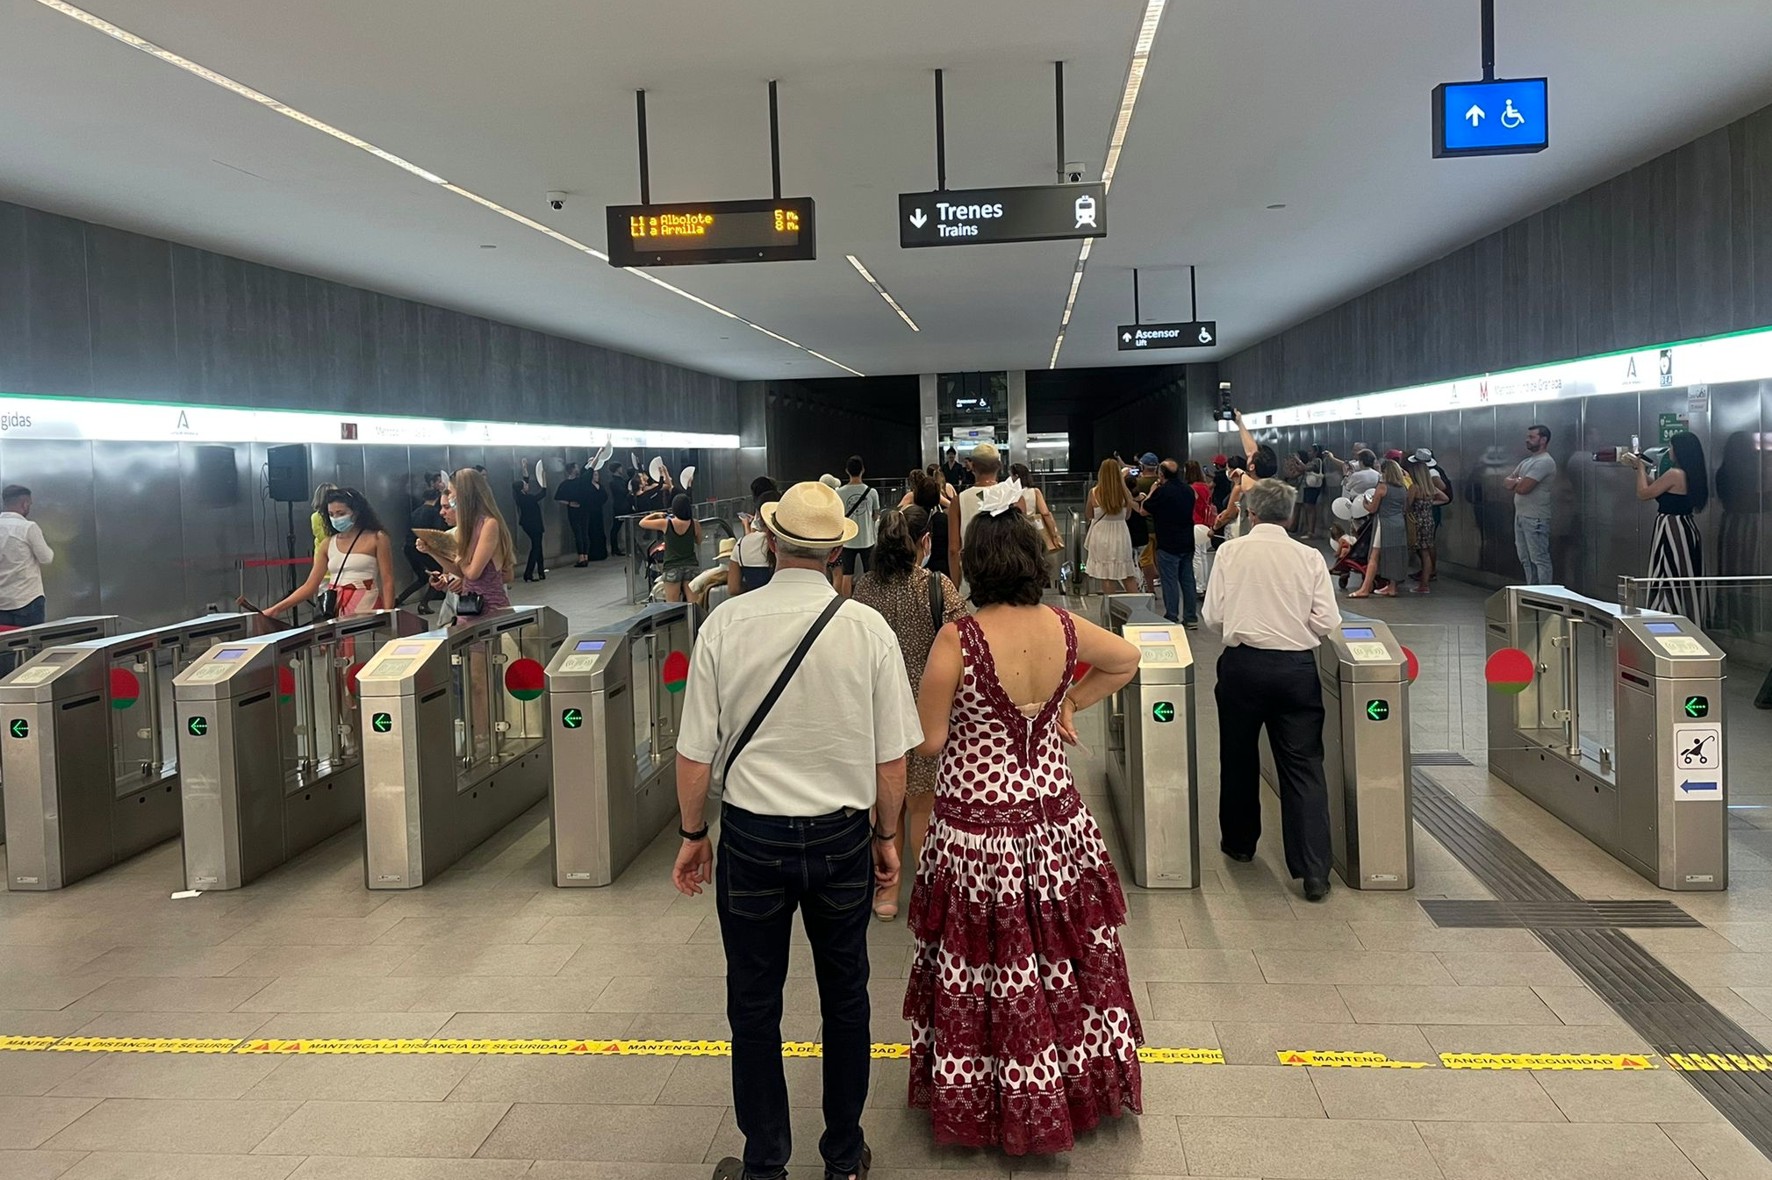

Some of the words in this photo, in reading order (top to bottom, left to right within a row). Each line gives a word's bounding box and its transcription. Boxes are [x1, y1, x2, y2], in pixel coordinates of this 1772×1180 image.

[936, 203, 1003, 220] Trenes
[661, 213, 713, 226] Albolote
[661, 224, 705, 236] Armilla
[937, 223, 978, 237] Trains
[1135, 329, 1180, 339] Ascensor
[1, 411, 32, 431] gidas
